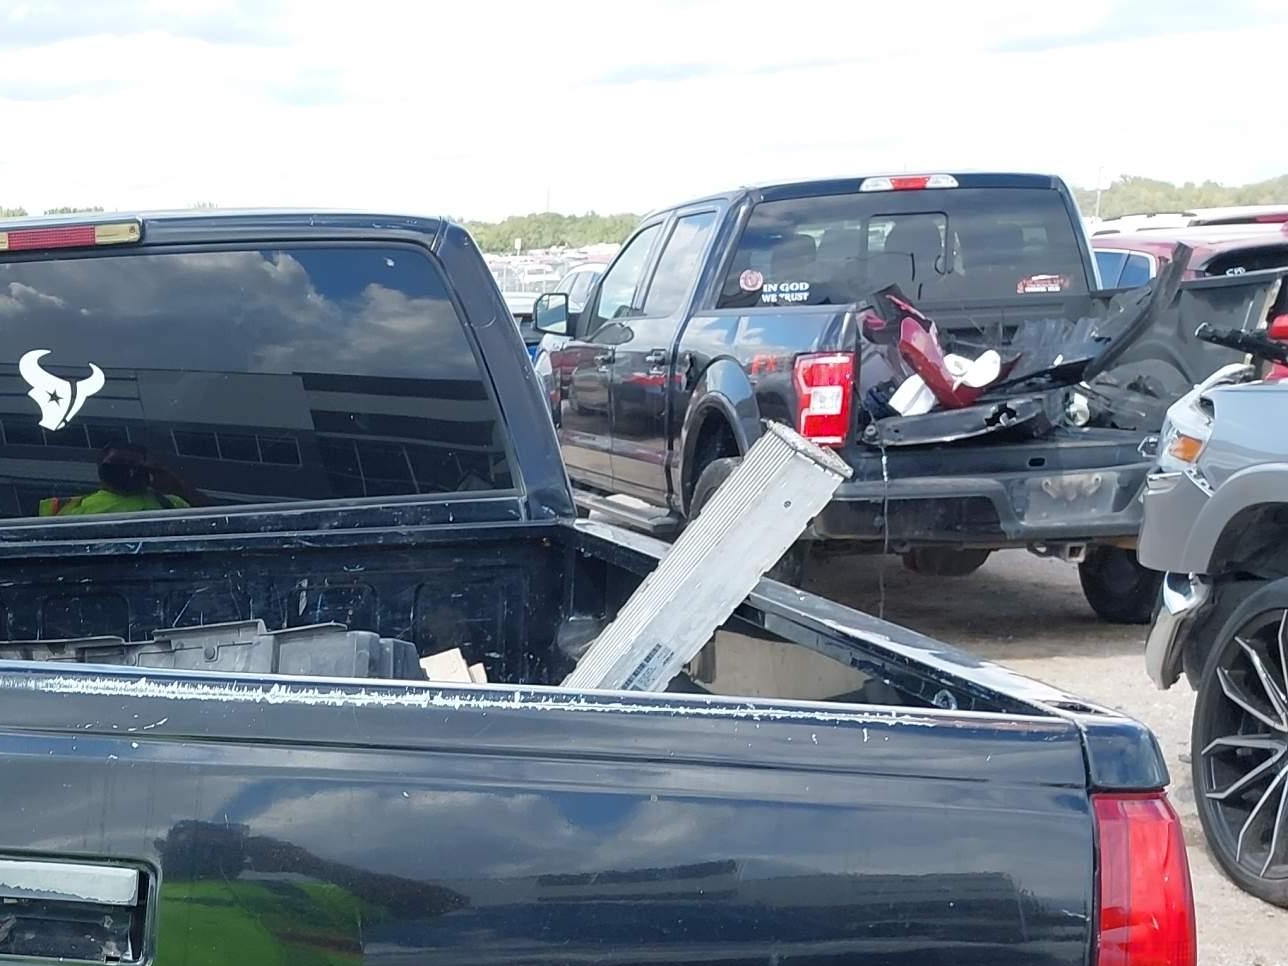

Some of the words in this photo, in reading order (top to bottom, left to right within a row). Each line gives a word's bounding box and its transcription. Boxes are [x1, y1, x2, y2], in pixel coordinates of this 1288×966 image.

[762, 283, 778, 292] IN
[779, 282, 809, 292] GOD
[761, 293, 777, 303] WE
[778, 292, 810, 303] TRUST
